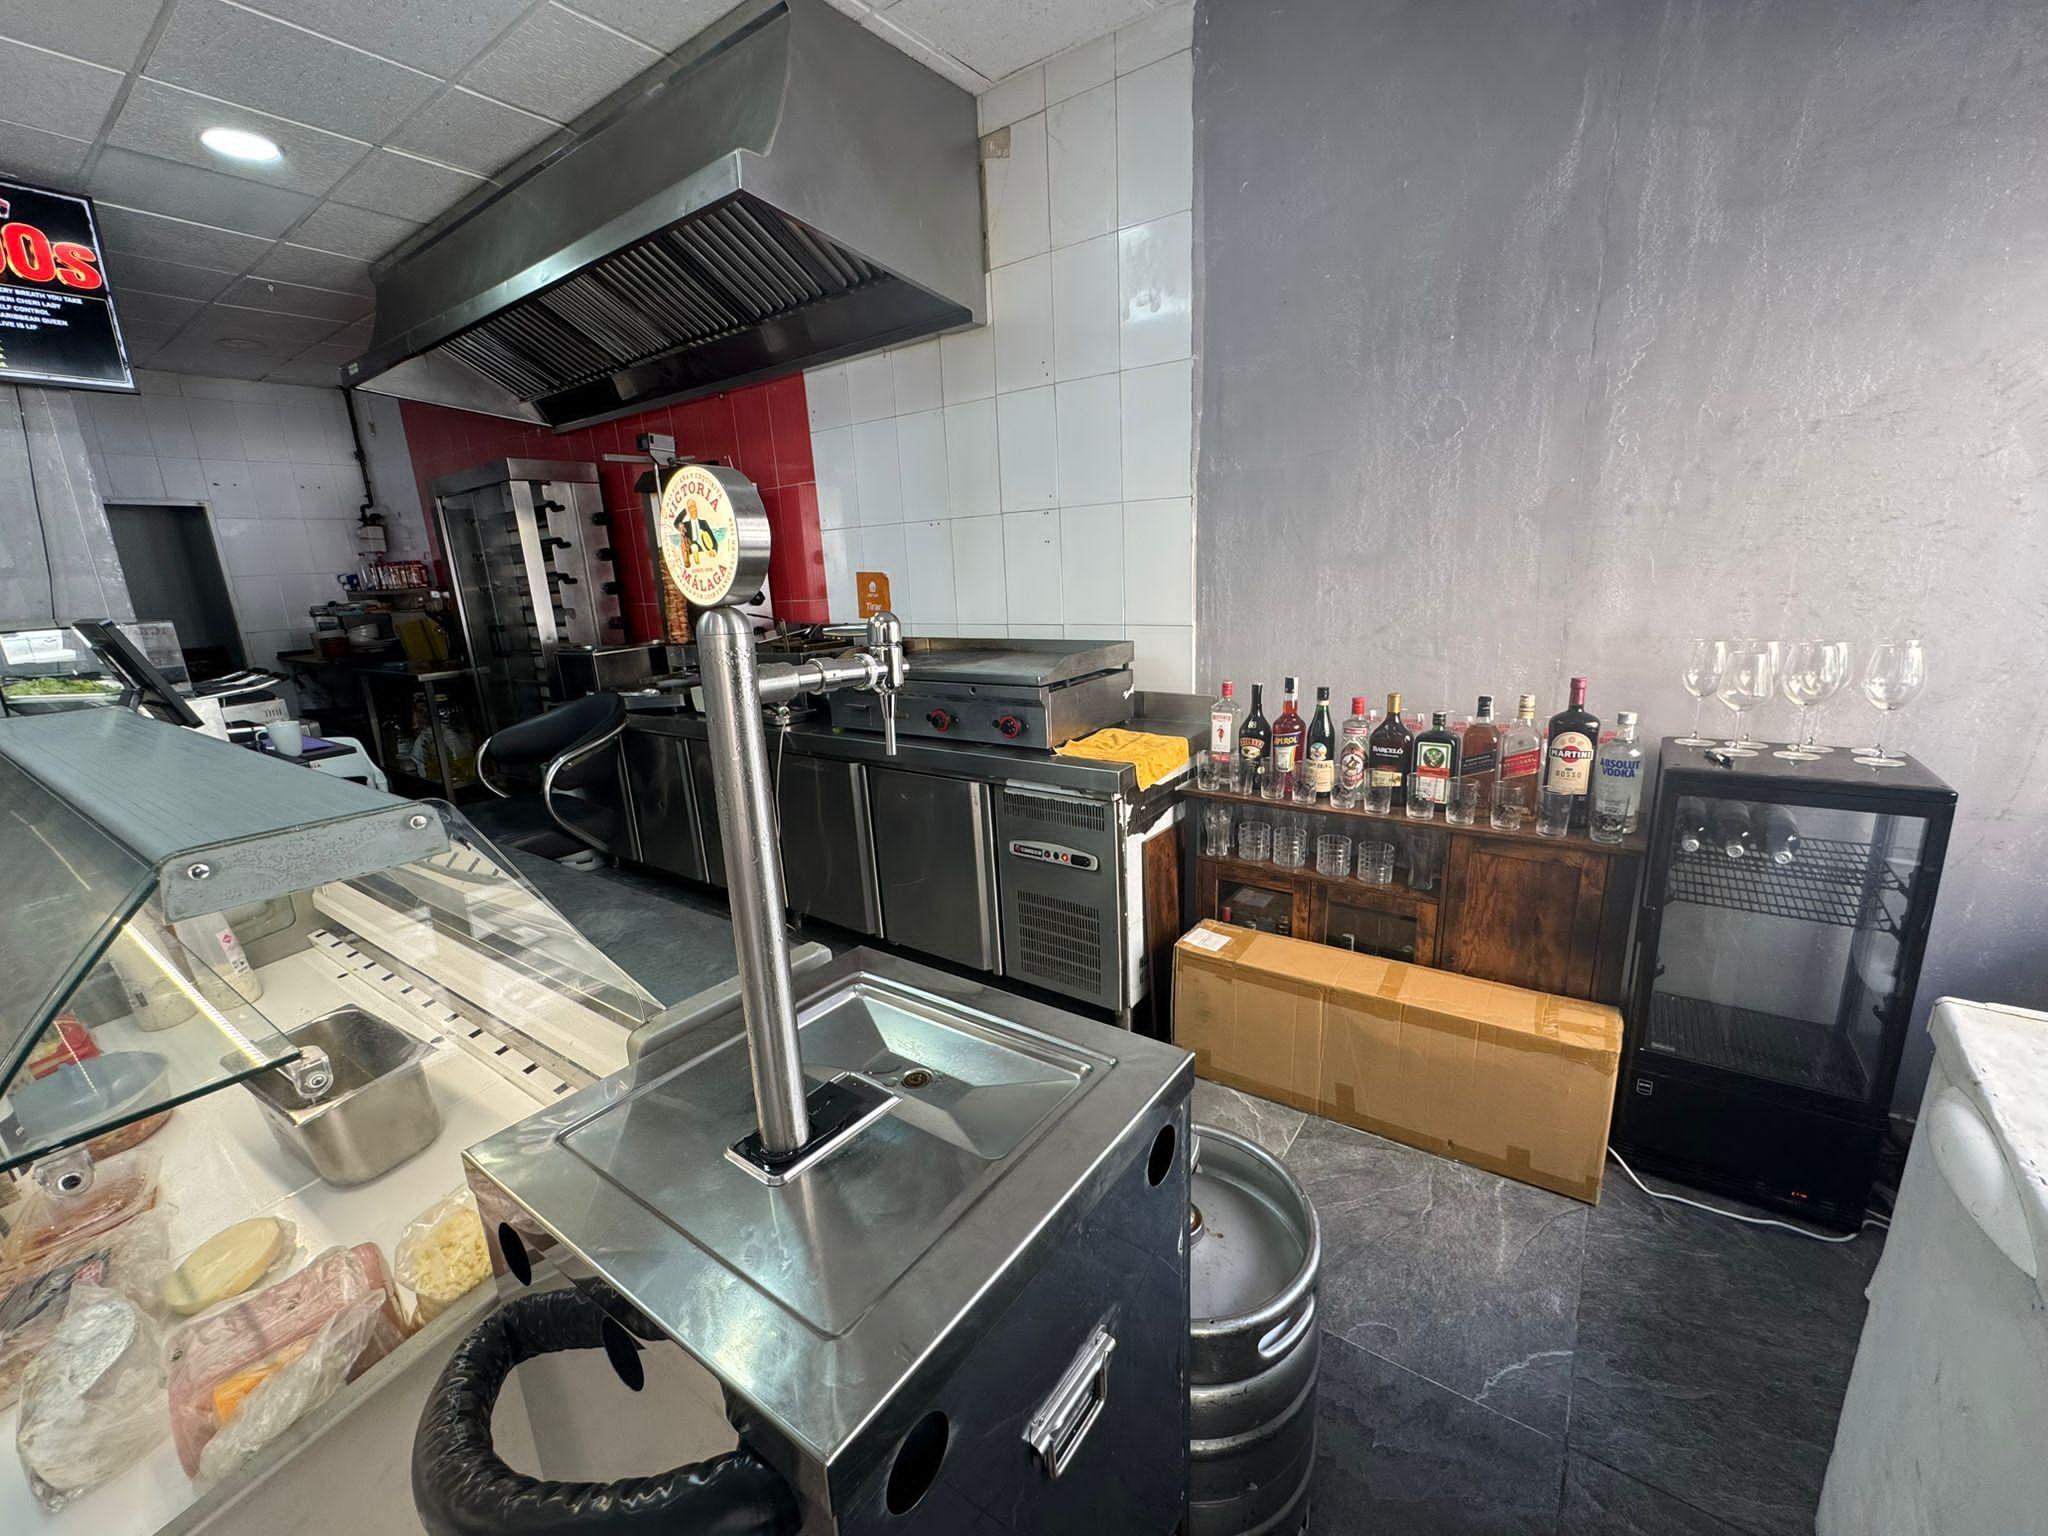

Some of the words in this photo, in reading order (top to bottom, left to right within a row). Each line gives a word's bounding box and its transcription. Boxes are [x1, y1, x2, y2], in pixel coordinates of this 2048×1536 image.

[0, 223, 102, 289] 0s
[13, 305, 51, 316] CONTROL
[668, 481, 720, 519] VICTORIA
[681, 564, 727, 591] MÁLAGA
[1551, 749, 1591, 758] MARTINI
[1600, 758, 1641, 769] ABSOLUT
[1602, 768, 1635, 778] VODKA
